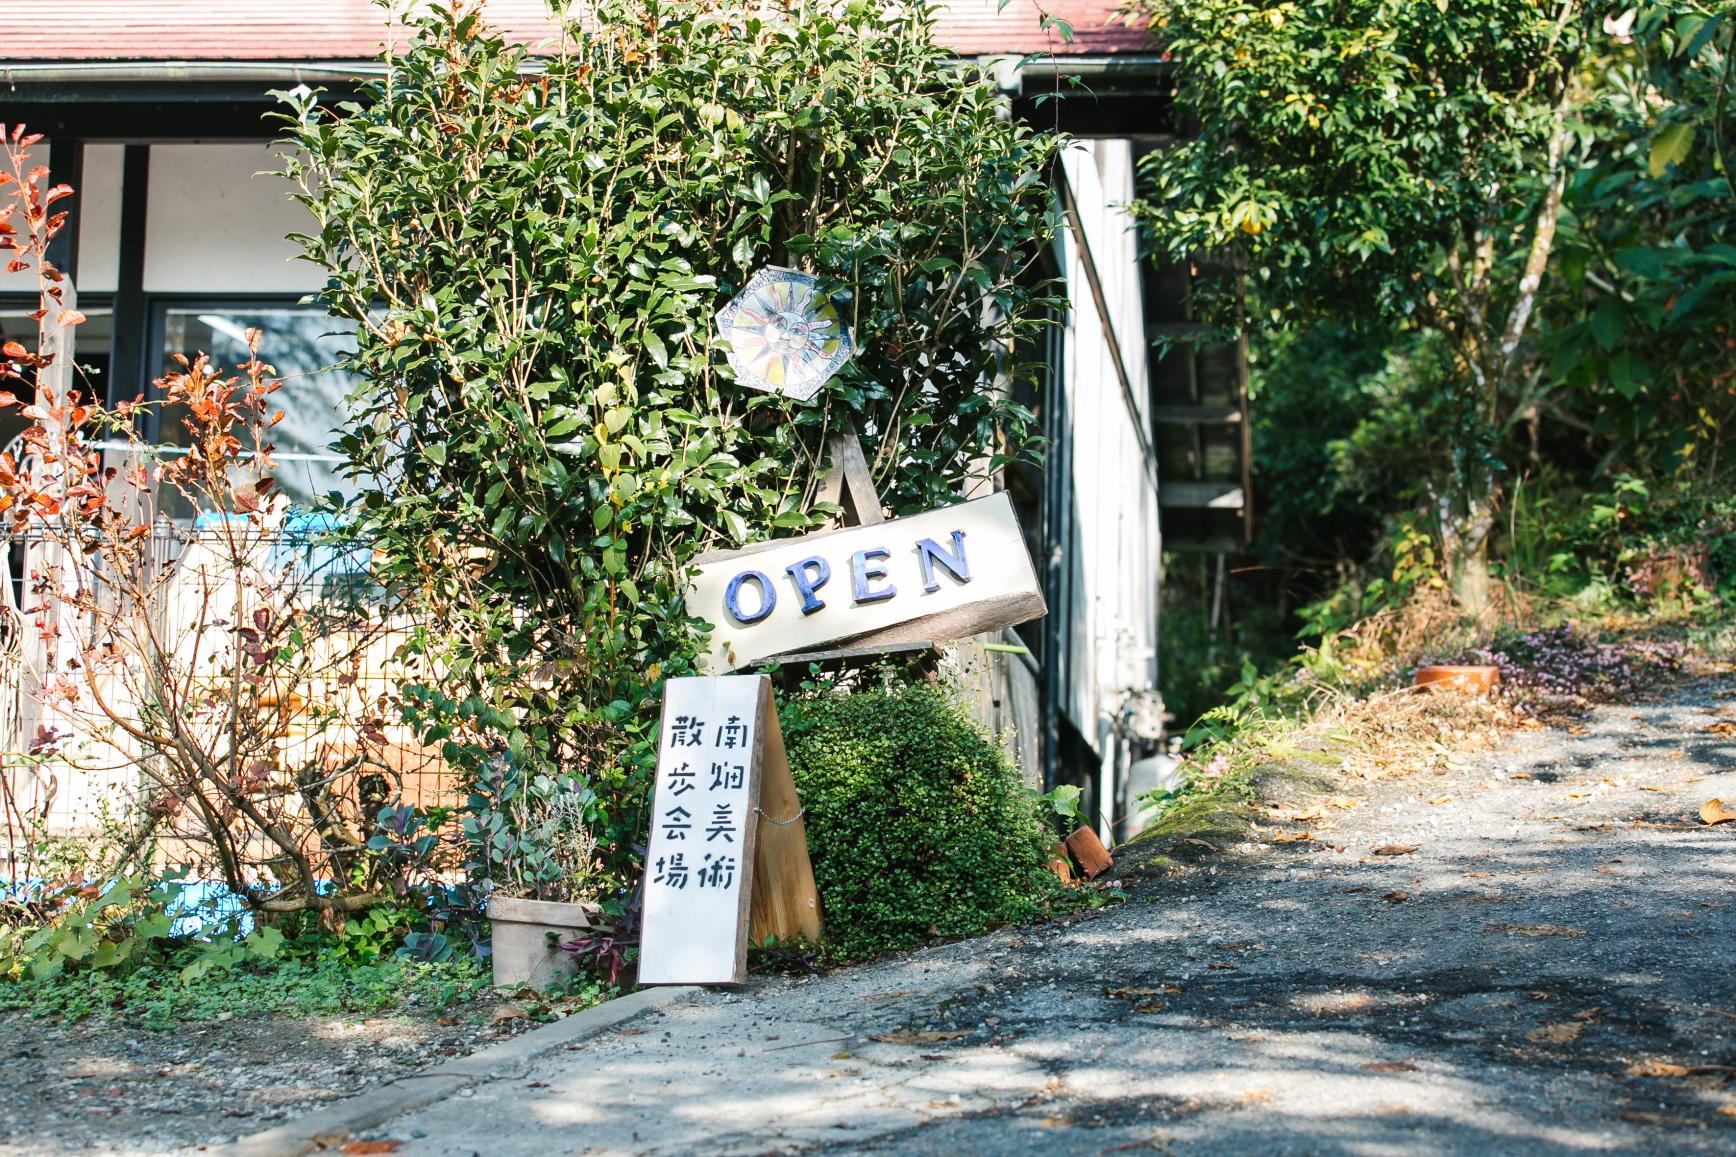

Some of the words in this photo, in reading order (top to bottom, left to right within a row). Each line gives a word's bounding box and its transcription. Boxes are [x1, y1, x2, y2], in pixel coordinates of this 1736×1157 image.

[725, 529, 972, 623] OPEN
[653, 715, 705, 889] 散歩会場
